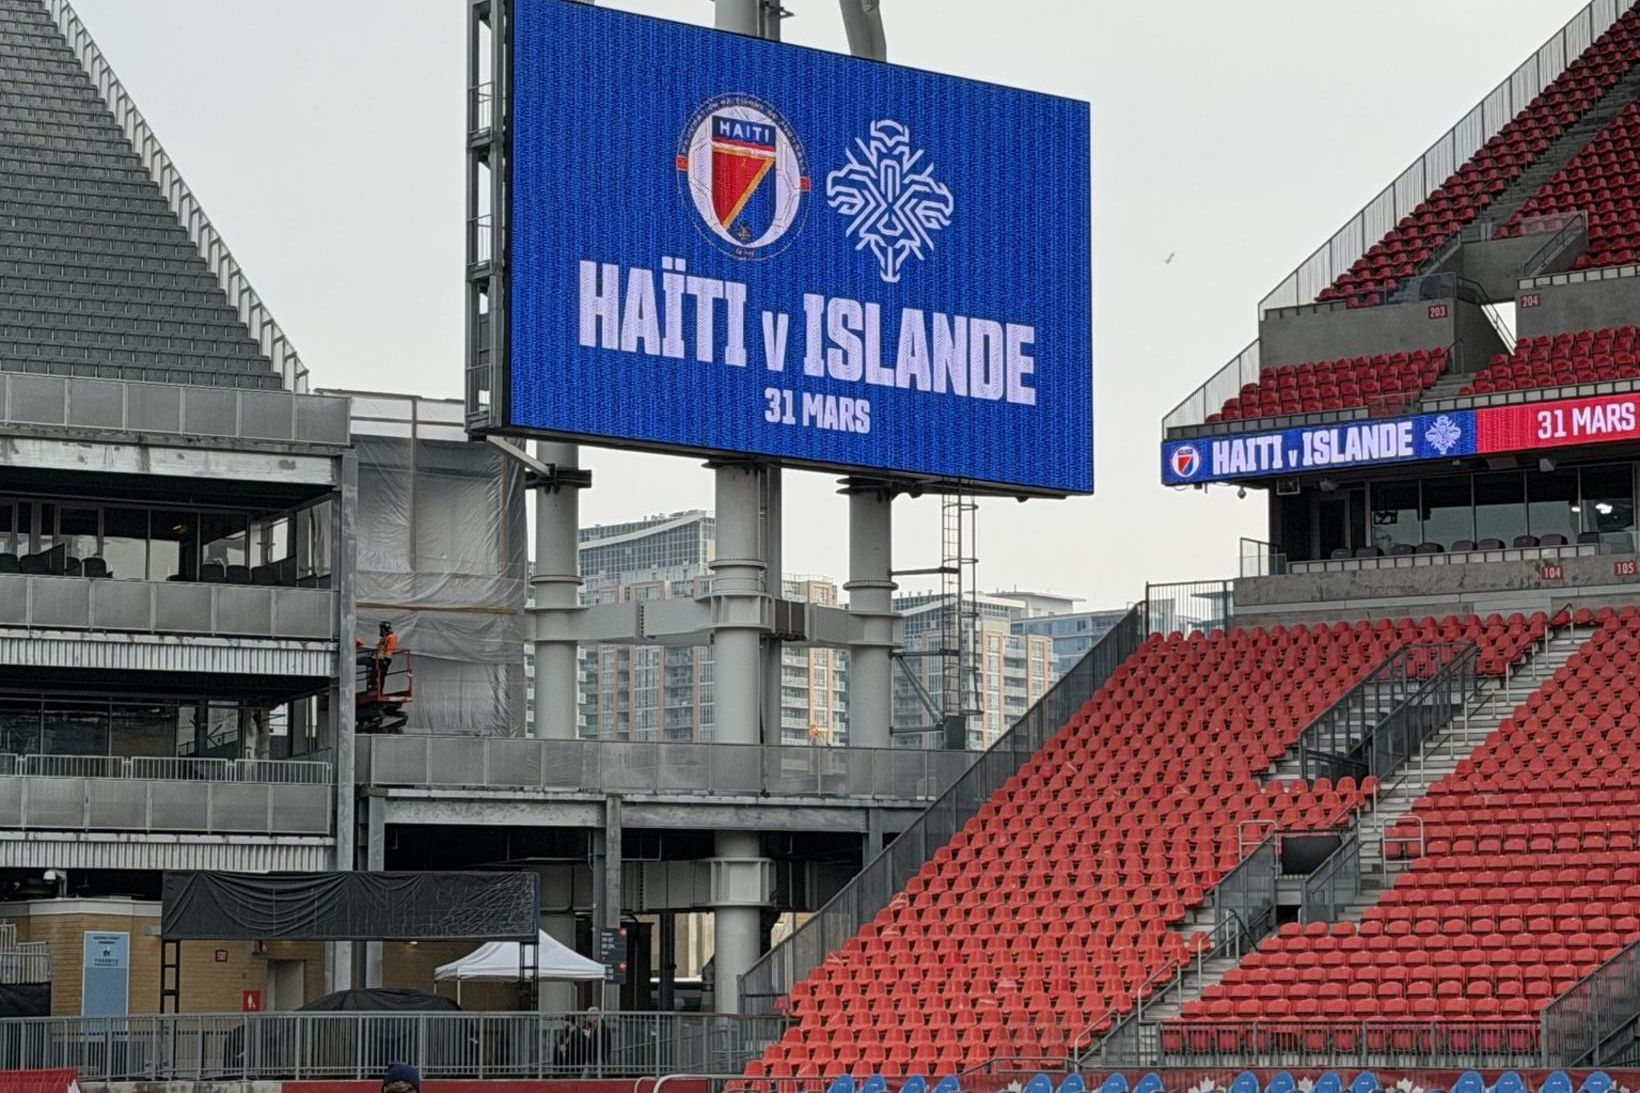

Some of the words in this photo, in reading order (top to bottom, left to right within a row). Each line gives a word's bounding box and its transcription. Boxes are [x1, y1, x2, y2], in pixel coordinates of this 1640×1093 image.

[719, 120, 770, 143] HAITI
[1429, 306, 1446, 318] 203
[1522, 296, 1538, 308] 204
[579, 256, 748, 368] HAÏTI
[802, 293, 1037, 407] ISLANDE
[764, 387, 797, 425] 31
[801, 392, 872, 435] MARS
[1537, 409, 1567, 439] 31
[1572, 402, 1636, 436] MARS
[1302, 420, 1414, 466] ISLANDE
[1543, 567, 1561, 579] 104
[1617, 562, 1634, 575] 105
